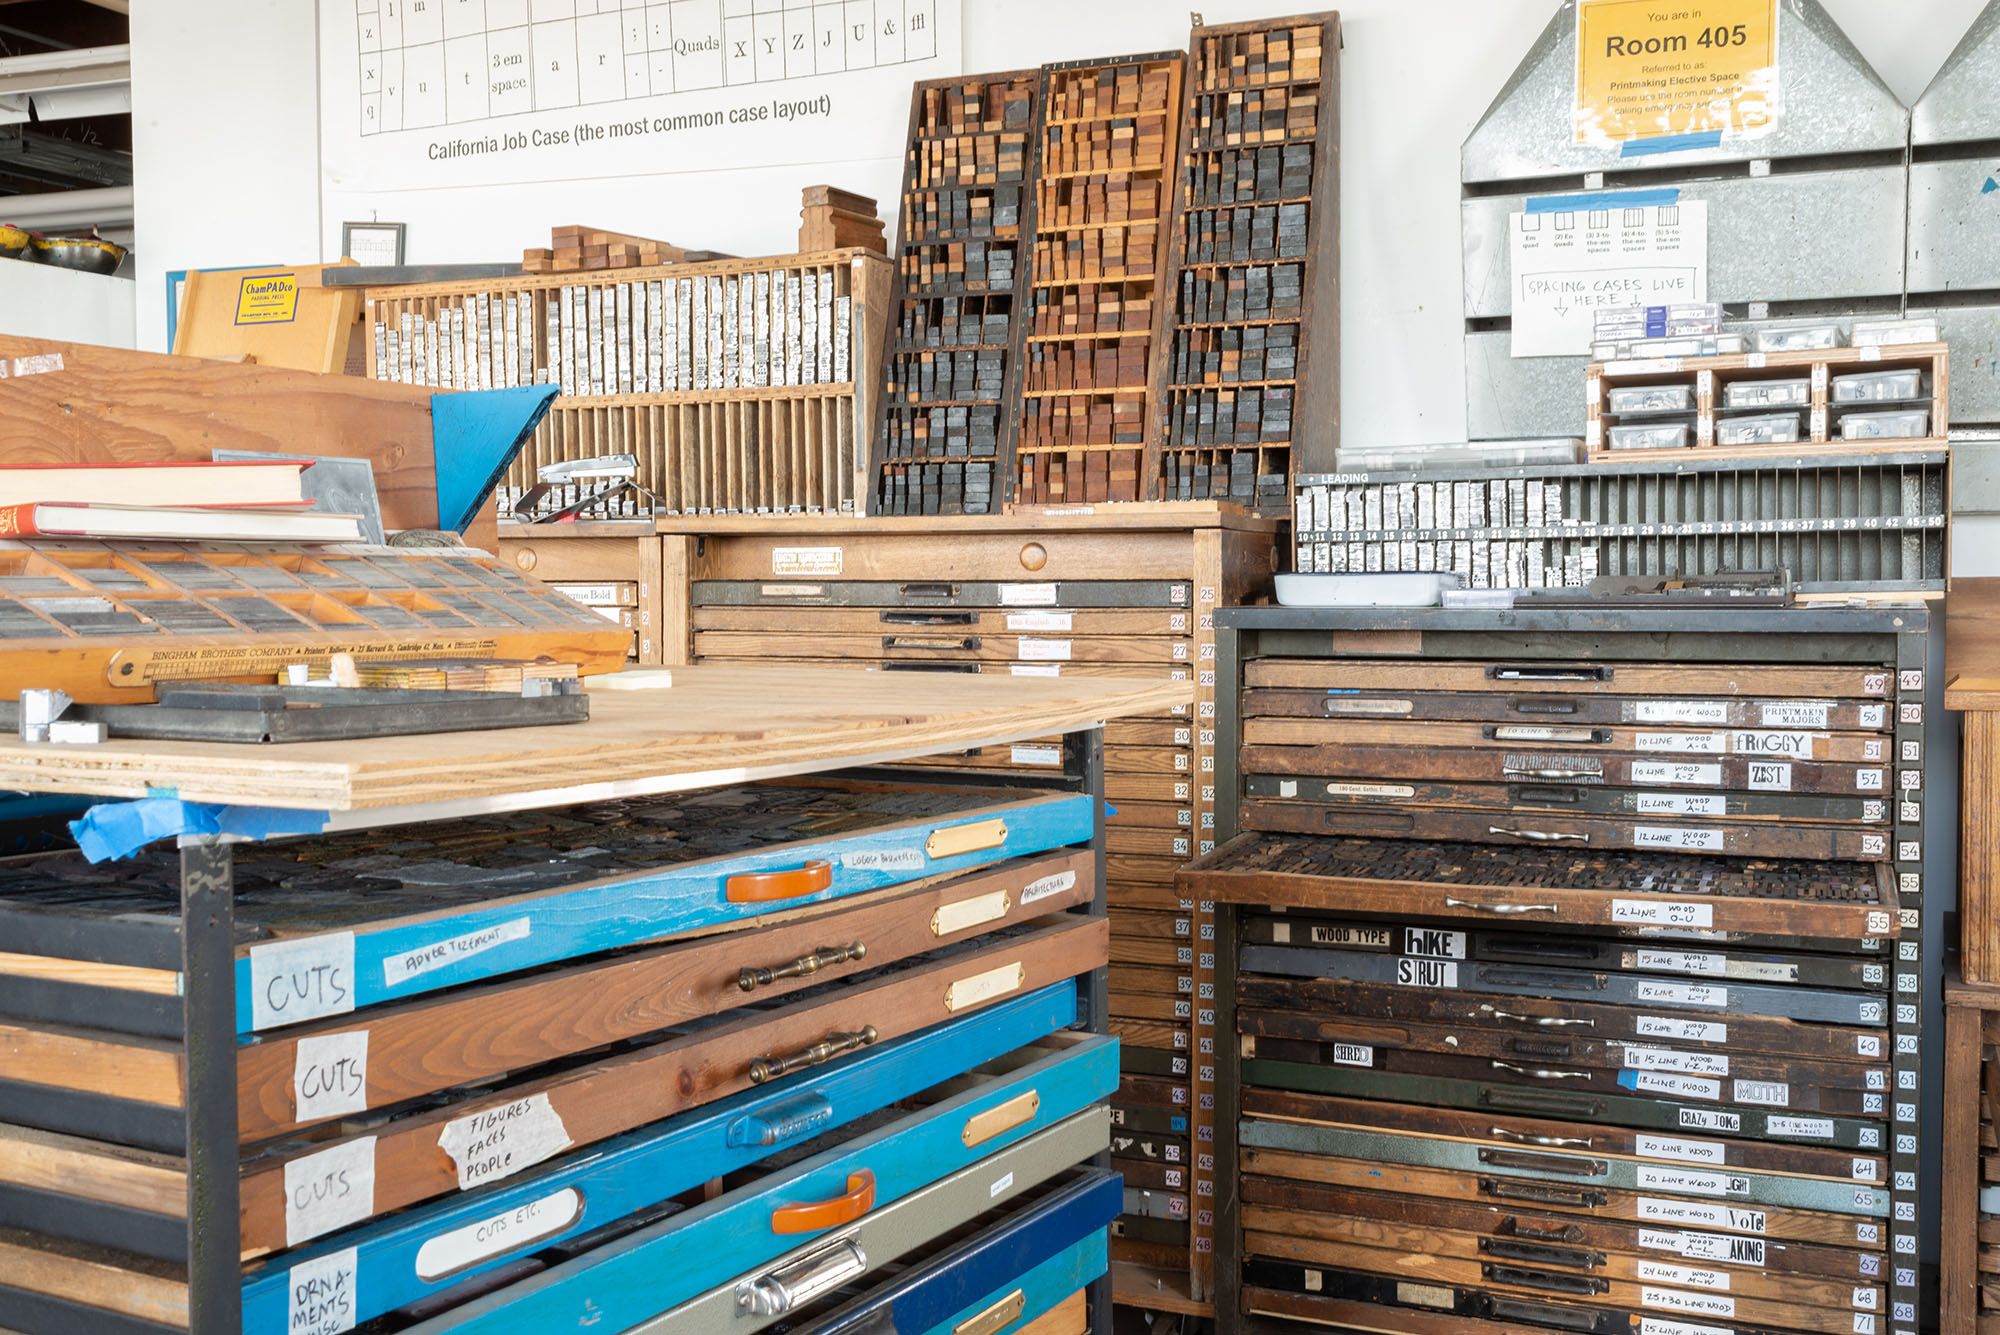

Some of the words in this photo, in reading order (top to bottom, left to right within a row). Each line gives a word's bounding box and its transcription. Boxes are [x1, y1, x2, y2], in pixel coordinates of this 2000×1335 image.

[1648, 13, 1668, 22] You
[1672, 12, 1689, 20] are
[1692, 9, 1701, 18] in
[853, 24, 865, 41] U
[884, 20, 896, 35] &
[763, 37, 776, 54] Y
[793, 34, 804, 50] Z
[823, 31, 832, 47] J
[1606, 35, 1687, 58] Room
[1697, 24, 1747, 49] 405
[674, 36, 720, 56] Quads
[734, 41, 747, 57] X
[504, 54, 522, 66] em
[1642, 63, 1680, 74] Referred
[1682, 63, 1692, 71] to
[492, 78, 526, 94] space
[1610, 78, 1667, 91] Printmaking
[1670, 75, 1707, 86] Elective
[1710, 72, 1740, 83] Space
[428, 137, 498, 160] California
[502, 132, 527, 151] Job
[532, 129, 570, 147] Case
[574, 122, 604, 146] (the
[609, 118, 649, 138] most
[653, 109, 724, 132] common
[729, 104, 768, 124] case
[773, 94, 832, 120] layout)
[246, 281, 293, 294] ChamPADco
[1528, 280, 1586, 295] SPACING
[1593, 279, 1642, 291] CASES
[1653, 278, 1686, 290] LIVE
[1575, 293, 1619, 305] HERE
[1321, 473, 1369, 483] LEADING
[1299, 533, 1308, 542] 10
[1384, 532, 1394, 540] 15
[1473, 529, 1484, 539] 20
[1603, 526, 1614, 536] 27
[1661, 525, 1673, 534] 30
[1802, 520, 1814, 530] 37
[1864, 519, 1877, 528] 40
[1907, 518, 1919, 527] 45
[1928, 516, 1941, 526] 50
[589, 589, 611, 600] Bold
[1172, 589, 1184, 600] 25
[152, 651, 197, 661] BINGHAM
[201, 649, 247, 659] BROTHERS
[250, 647, 293, 657] COMPANY
[1174, 646, 1186, 657] 27
[1903, 675, 1920, 686] 49
[1783, 716, 1821, 724] MAJORS
[1864, 711, 1877, 721] 50
[1175, 731, 1189, 741] 30
[1649, 737, 1672, 745] LINE
[1903, 746, 1918, 756] 51
[1202, 759, 1213, 768] 31
[1752, 766, 1784, 783] ZEST
[1862, 774, 1878, 785] 52
[1653, 800, 1674, 808] LINE
[1903, 805, 1918, 816] 53
[1179, 812, 1190, 822] 33
[1651, 834, 1672, 842] LINE
[1630, 907, 1656, 918] LINE
[1669, 905, 1695, 913] WOOD
[1870, 916, 1887, 929] 55
[1316, 928, 1350, 943] WOOD
[1356, 930, 1386, 945] TYPE
[1902, 945, 1917, 956] 57
[1653, 957, 1672, 965] LINE
[1399, 960, 1446, 987] STRUT
[1865, 969, 1881, 979] 58
[267, 966, 346, 1012] CUTS
[1200, 985, 1213, 995] 39
[1642, 1023, 1652, 1031] 15
[1175, 1034, 1186, 1045] 41
[1860, 1040, 1875, 1051] 60
[1335, 1045, 1369, 1064] SHRED
[1645, 1055, 1655, 1064] 15
[1658, 1057, 1678, 1065] LINE
[1690, 1055, 1712, 1063] WOOD
[1173, 1061, 1186, 1071] 42
[302, 1057, 363, 1099] CUTS
[1638, 1076, 1648, 1084] 18
[1650, 1079, 1676, 1088] LINE
[1682, 1083, 1710, 1093] WOOD
[1737, 1082, 1785, 1102] MOTH
[471, 1099, 531, 1134] FIGURES
[467, 1129, 506, 1160] FACES
[1645, 1142, 1657, 1151] 20
[1662, 1144, 1682, 1153] LINE
[1689, 1147, 1713, 1157] WOOD
[1898, 1139, 1914, 1150] 63
[1167, 1174, 1179, 1183] 46
[1646, 1174, 1657, 1183] 20
[1662, 1175, 1685, 1185] LINE
[1688, 1179, 1717, 1188] WOOD
[295, 1169, 350, 1210] CUTS
[1646, 1205, 1658, 1214] 20
[1663, 1208, 1685, 1216] LINE
[1689, 1210, 1715, 1220] WOOD
[476, 1217, 507, 1242] CUTS
[515, 1203, 541, 1225] ETC.
[1643, 1267, 1655, 1275] 24
[1657, 1269, 1678, 1278] LINE
[1858, 1291, 1870, 1303] 68
[292, 1291, 350, 1329] MENTS
[1857, 1317, 1869, 1329] 71
